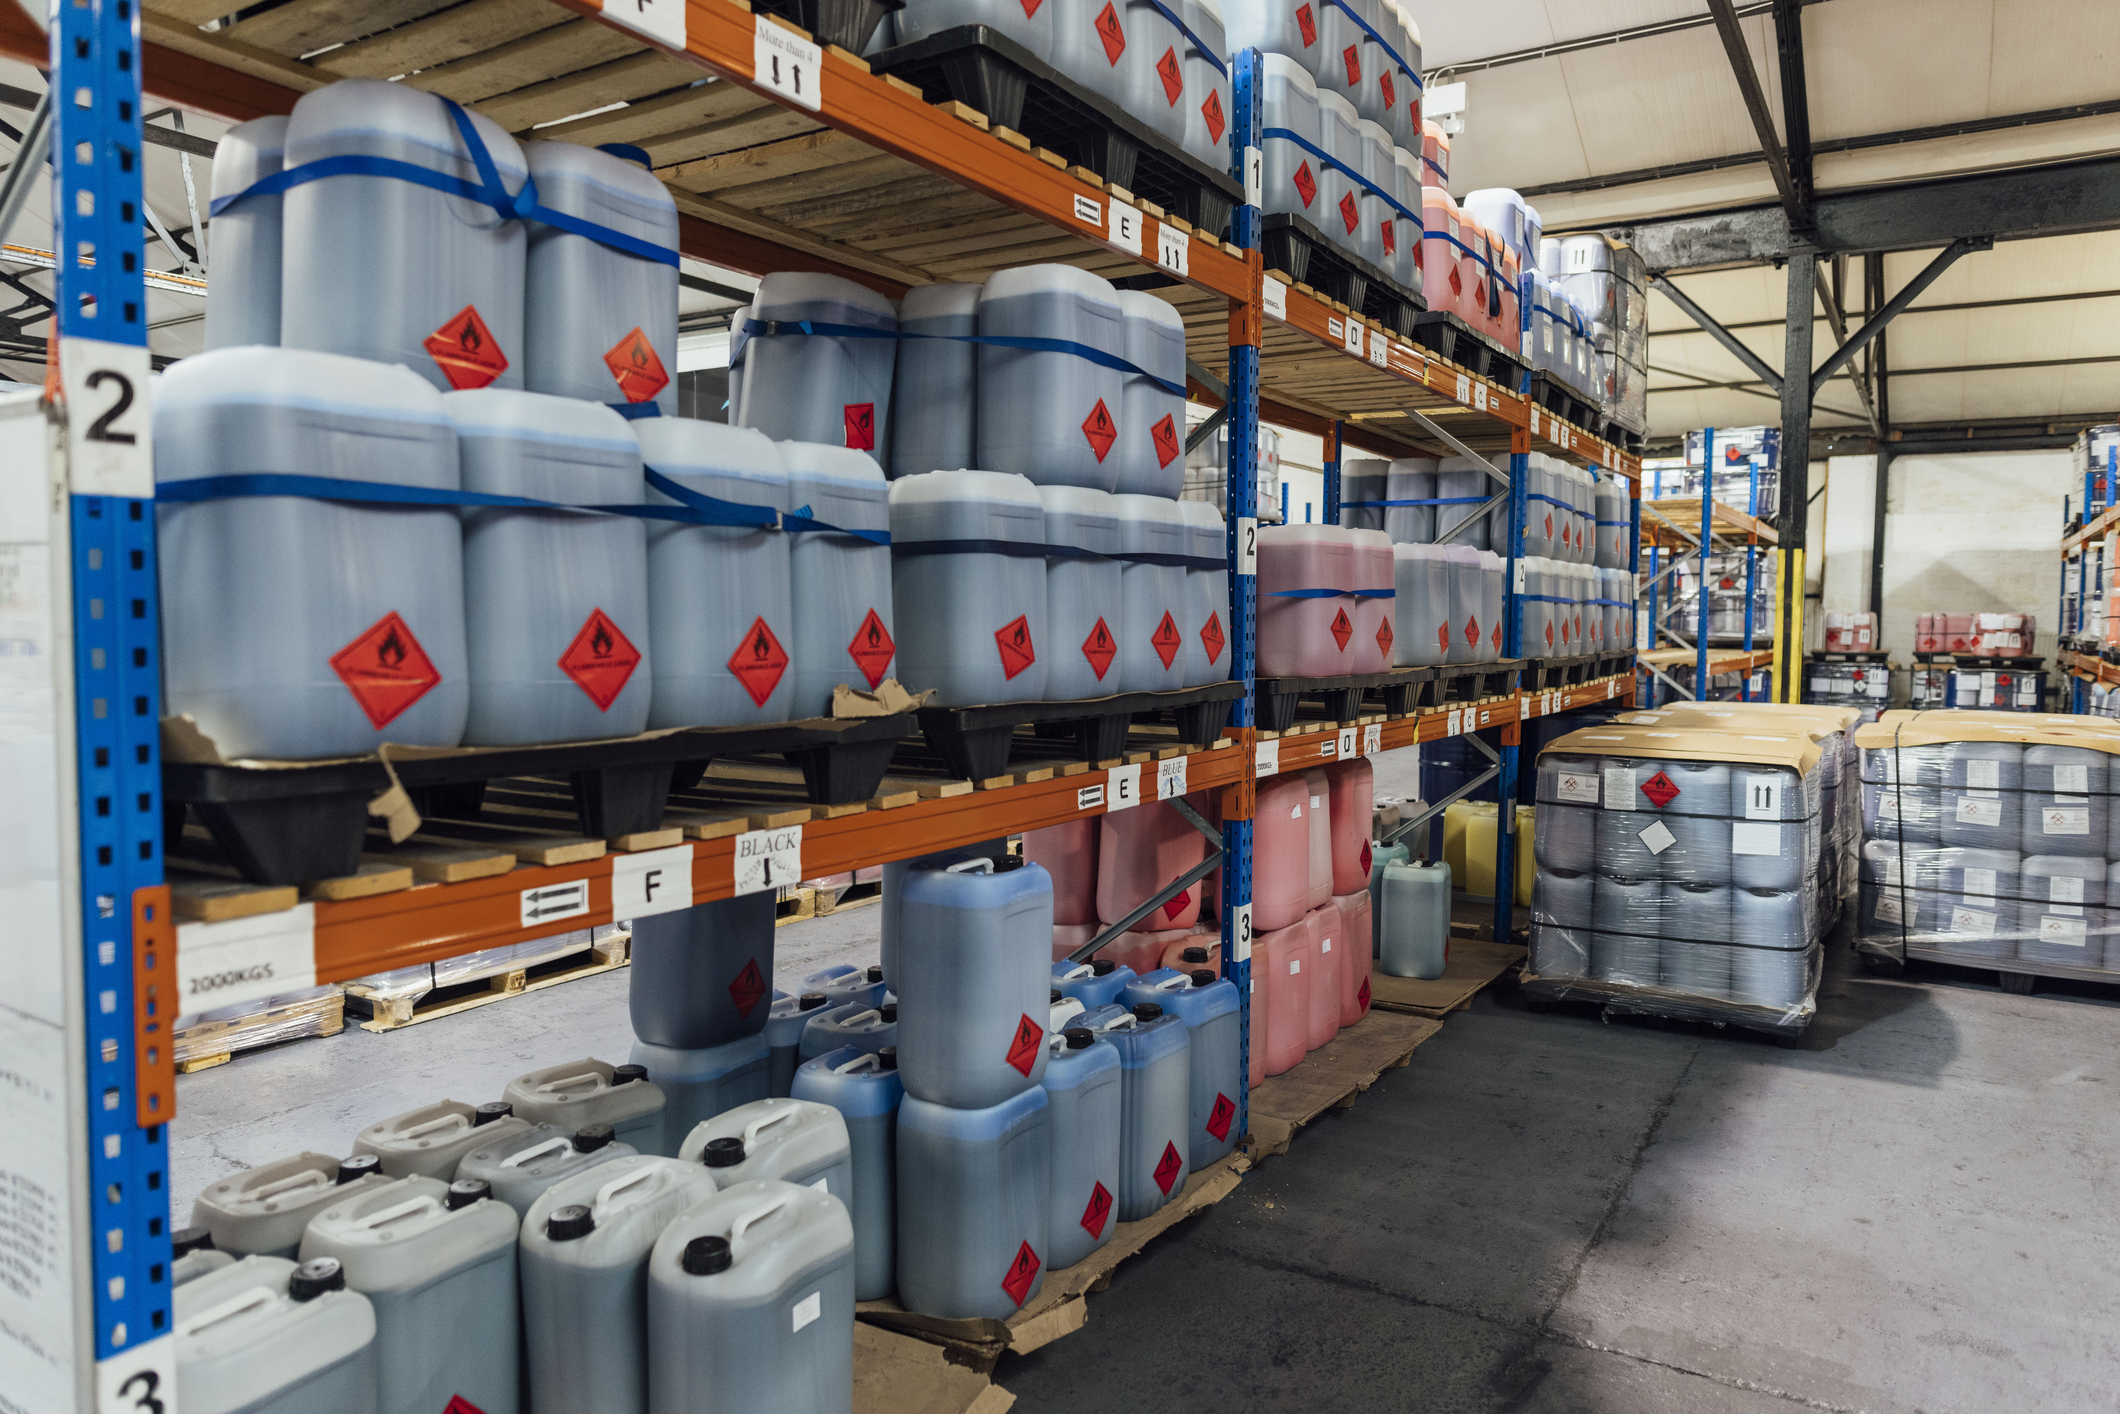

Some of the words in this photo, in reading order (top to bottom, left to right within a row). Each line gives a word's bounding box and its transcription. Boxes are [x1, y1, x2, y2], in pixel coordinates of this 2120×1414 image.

[759, 26, 783, 49] More
[786, 38, 805, 59] than
[806, 51, 813, 63] 4
[1253, 159, 1259, 189] 1
[1121, 216, 1130, 239] E
[86, 369, 135, 446] 2
[1246, 527, 1254, 556] 2
[1519, 564, 1524, 582] 2
[1467, 715, 1471, 728] C
[1162, 761, 1183, 776] BLUE
[1119, 778, 1129, 799] E
[740, 832, 796, 858] BLACK
[645, 869, 662, 903] F
[1241, 913, 1250, 942] 3
[189, 962, 275, 995] 2000KGS
[118, 1369, 164, 1414] 3
